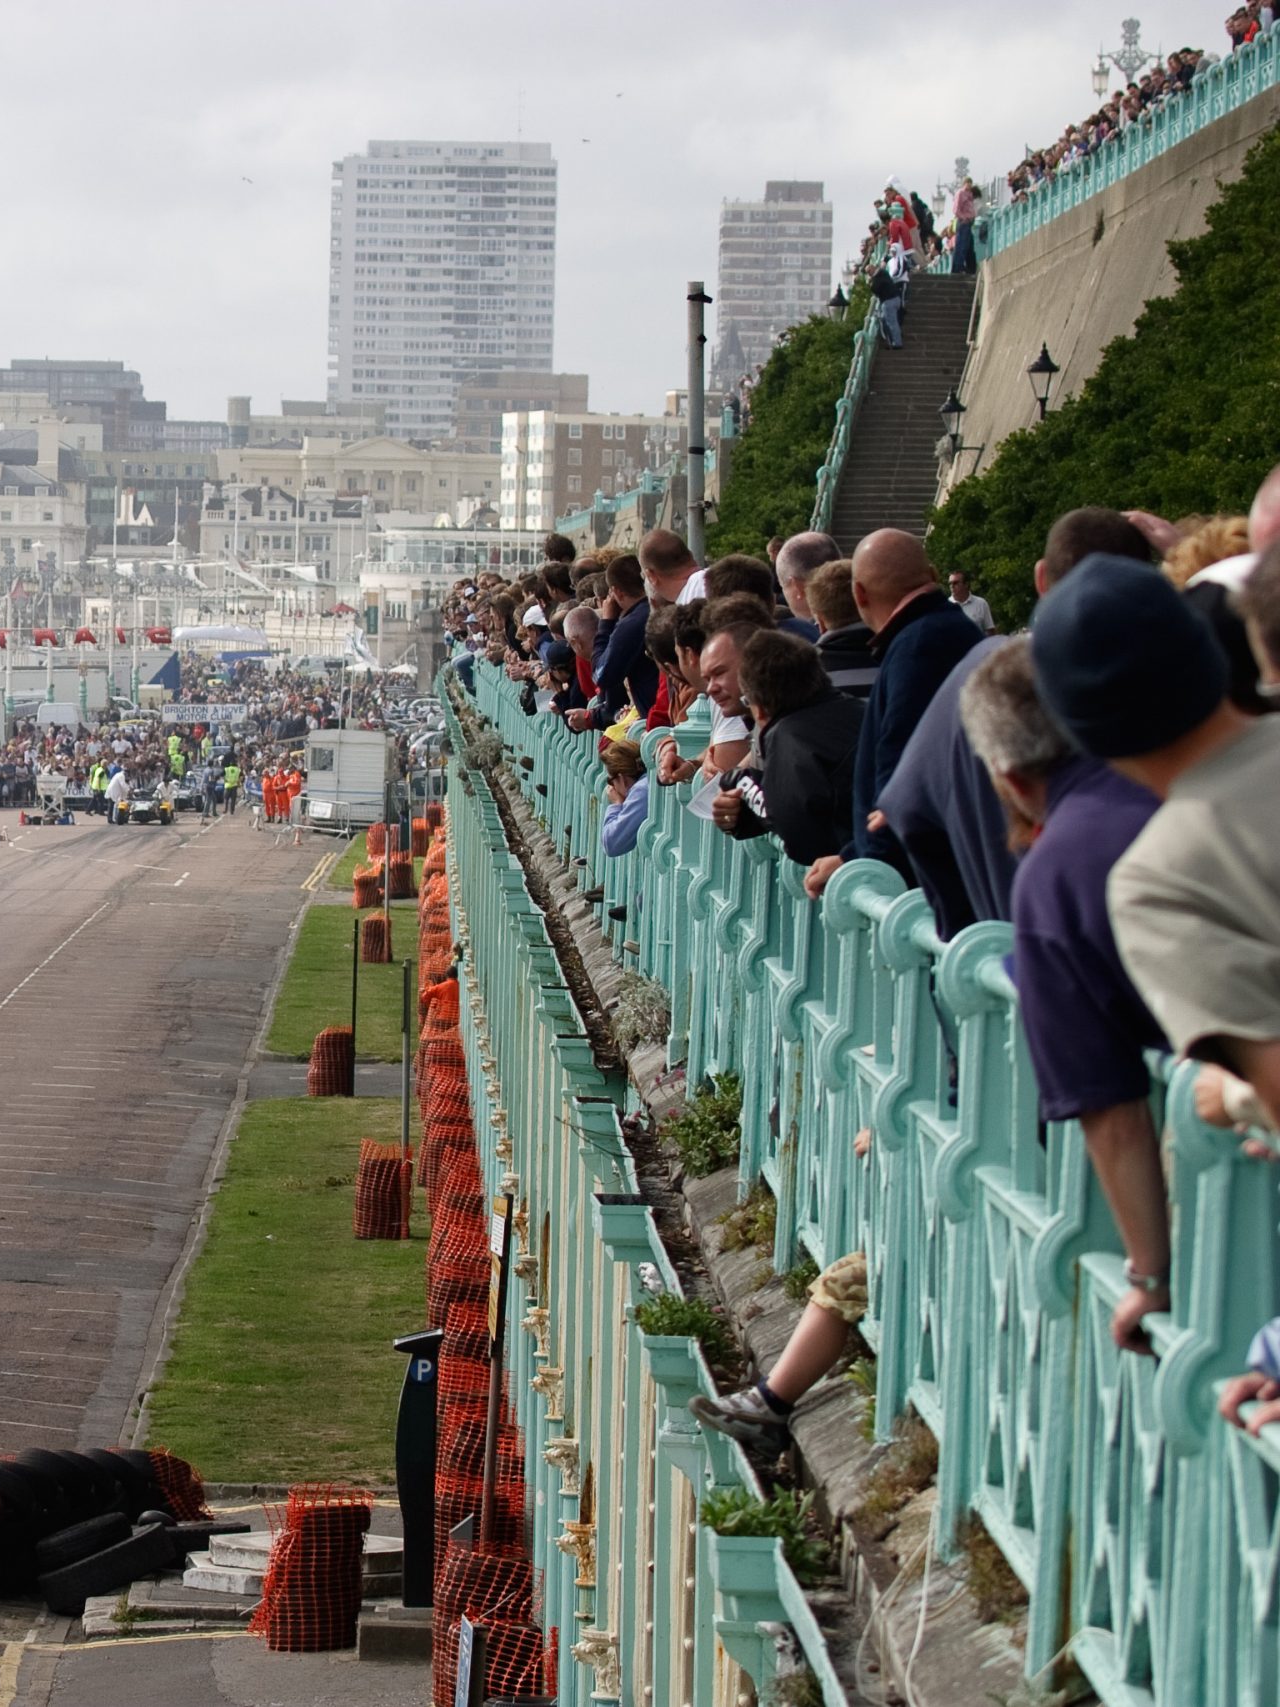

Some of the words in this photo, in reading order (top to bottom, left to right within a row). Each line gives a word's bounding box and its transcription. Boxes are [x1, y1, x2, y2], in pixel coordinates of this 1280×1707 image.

[164, 706, 209, 714] BRIGHTON
[221, 706, 245, 714] HOVE
[176, 713, 207, 721] MOTOR
[210, 713, 233, 721] CLUB
[417, 1359, 432, 1381] P
